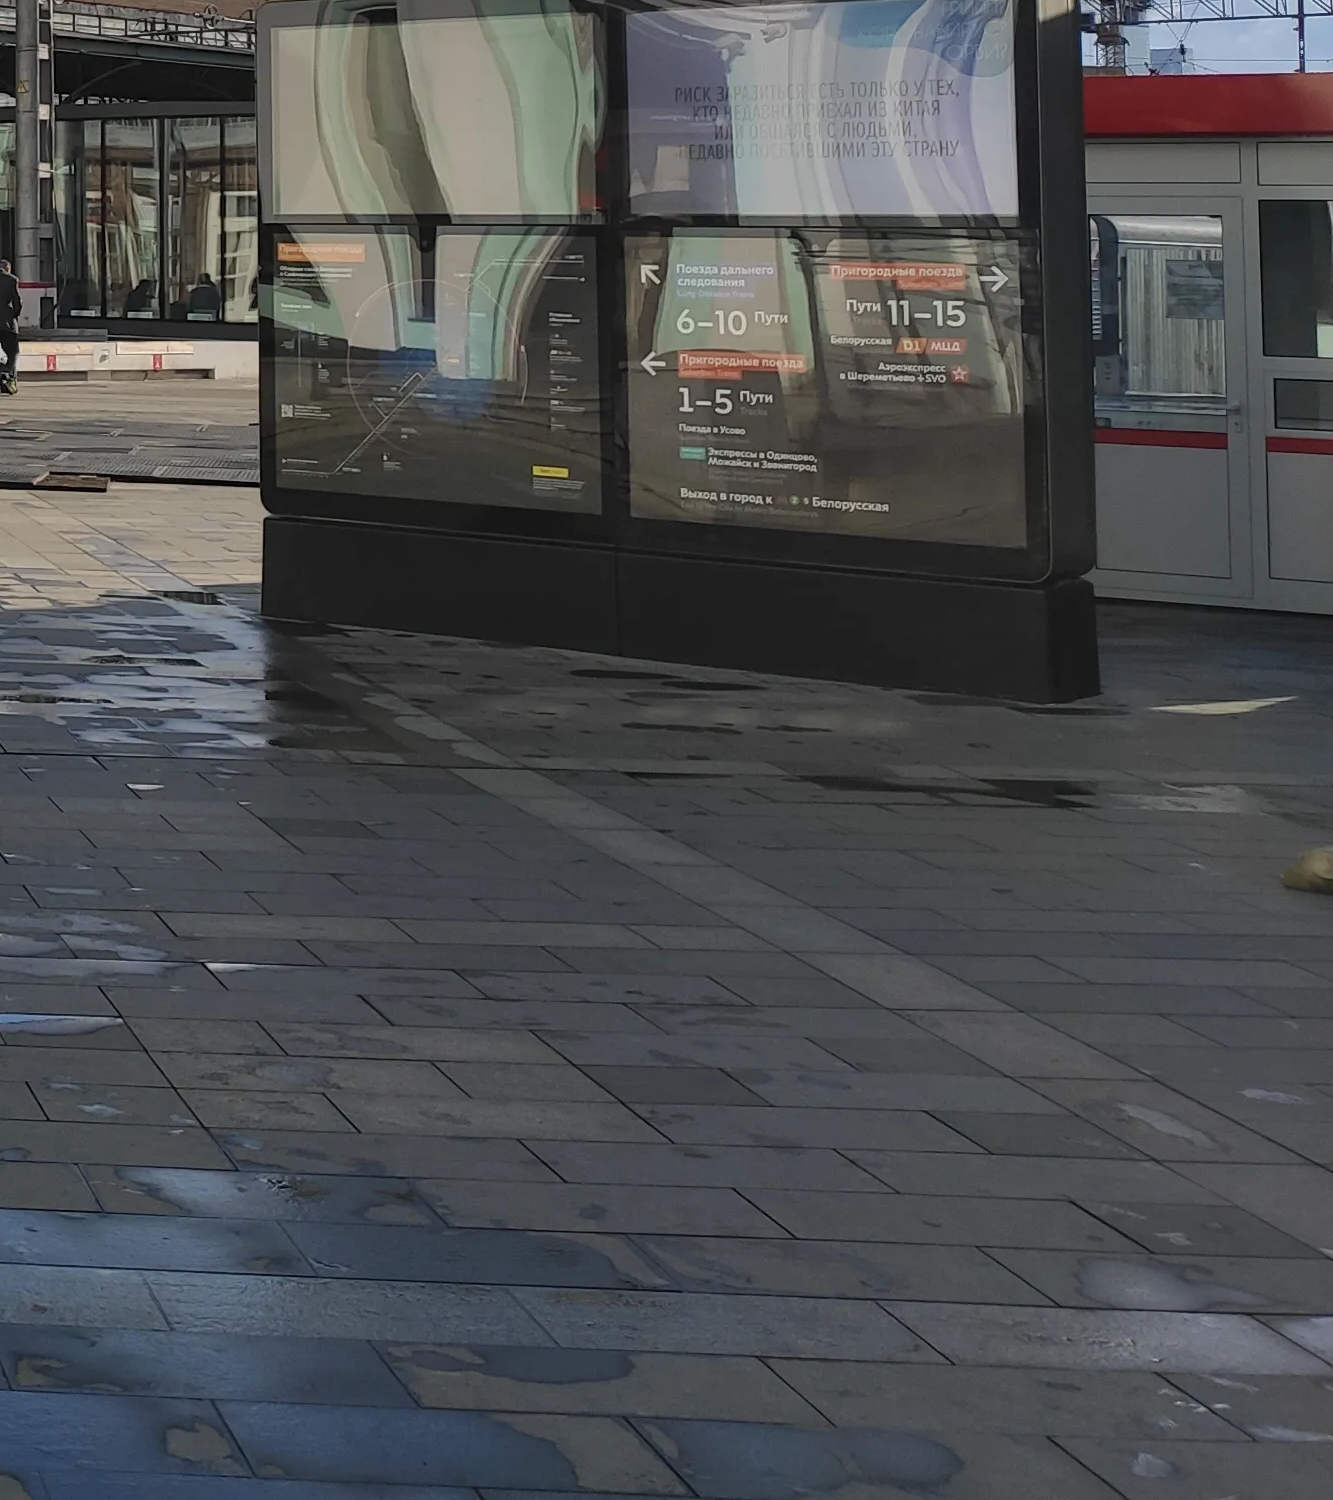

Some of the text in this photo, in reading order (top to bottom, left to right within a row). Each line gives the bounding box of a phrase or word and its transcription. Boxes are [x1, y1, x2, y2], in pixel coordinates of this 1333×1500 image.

[675, 87, 711, 102] РИСК
[717, 84, 805, 102] ЗАРАЗИТЬСЯ
[850, 80, 908, 98] ТОЛЬКО
[914, 80, 923, 97] У
[929, 79, 959, 97] ТЕХ,
[693, 100, 941, 121] КТО НЕДАВНО ПРИЕХАЛ ИЗ КИТАЯ
[714, 124, 744, 140] ИЛИ
[827, 122, 836, 138] С
[842, 121, 917, 139] ЛЮДЬМИ,
[871, 141, 897, 157] ЭТУ
[904, 140, 959, 156] СТРАНУ
[676, 264, 774, 276] Поезда дальнего
[831, 265, 963, 278] Пригородные поезда
[677, 278, 745, 288] следования
[846, 300, 881, 314] Пути
[754, 311, 789, 326] Пути
[831, 335, 892, 346] Белорусская
[903, 340, 921, 351] D1
[679, 354, 804, 369] Пригородные поезда
[878, 362, 946, 373] Аэроэкспресс
[847, 372, 915, 382] Шереметьево
[739, 390, 774, 404] Пути
[679, 423, 711, 433] Поезда
[720, 426, 746, 435] Усово
[708, 447, 757, 458] Экспрессы
[766, 450, 818, 463] Одинцово,
[708, 457, 752, 468] Можайск
[761, 460, 817, 472] Звенигород
[680, 487, 718, 502] Выход
[720, 492, 727, 500] в
[729, 493, 764, 505] город
[765, 496, 773, 504] к
[812, 496, 890, 512] Белорусская
